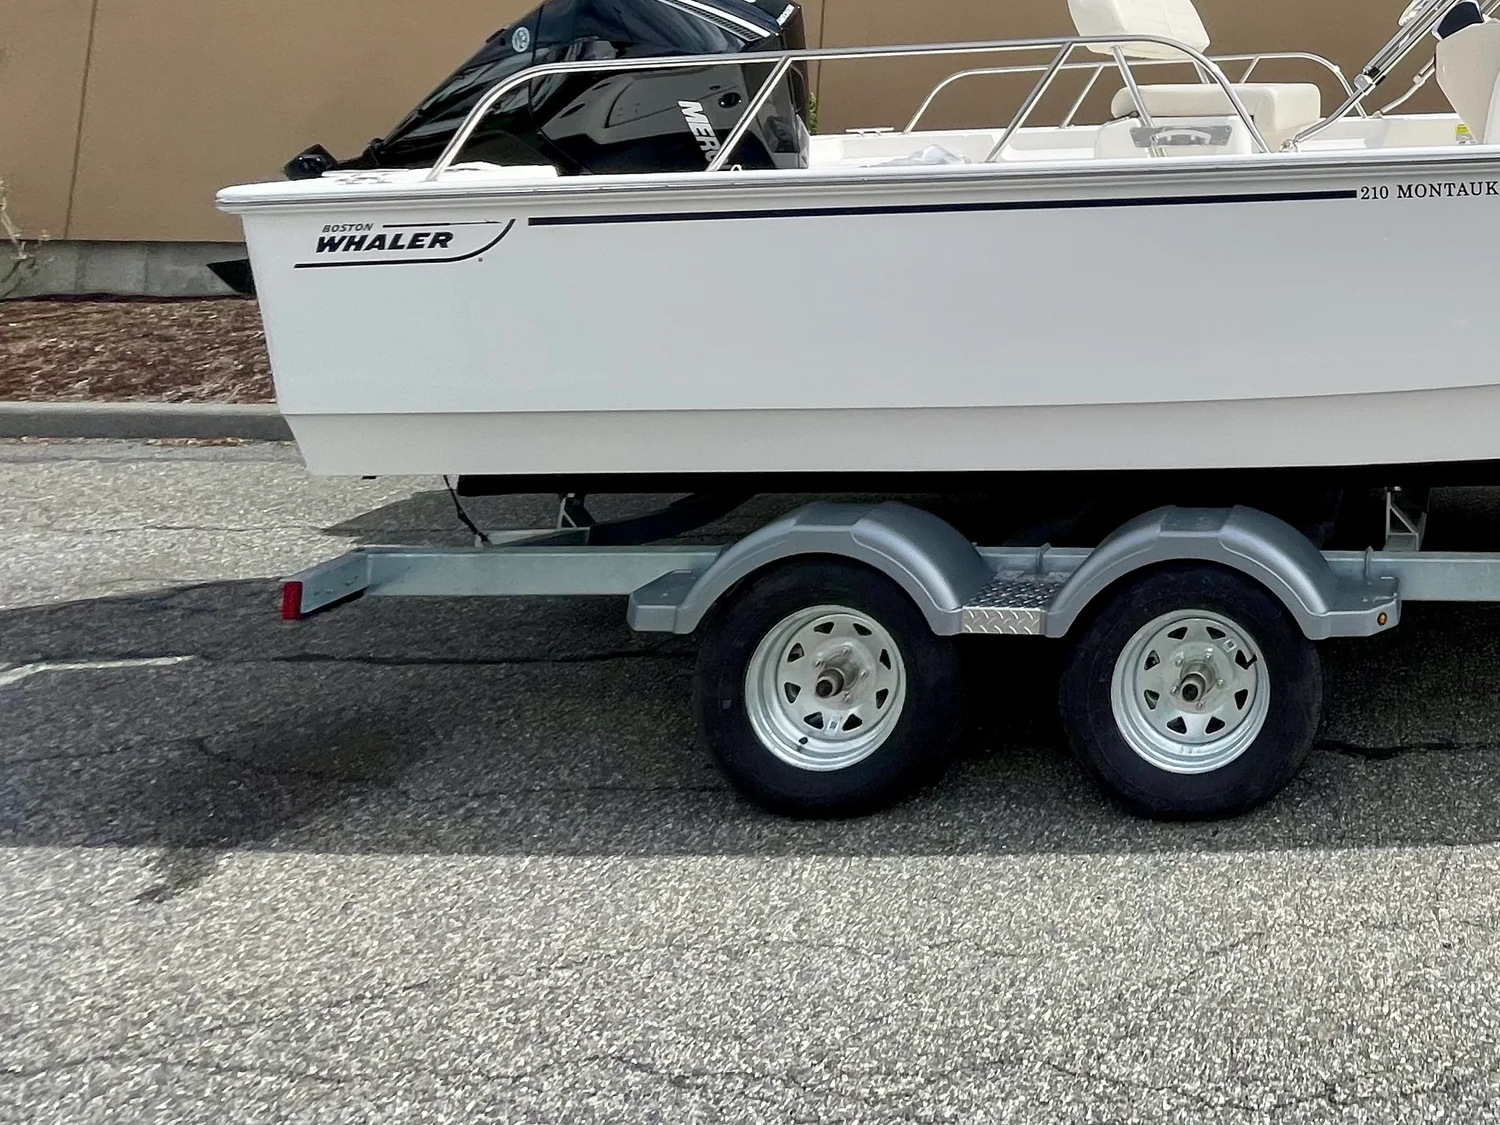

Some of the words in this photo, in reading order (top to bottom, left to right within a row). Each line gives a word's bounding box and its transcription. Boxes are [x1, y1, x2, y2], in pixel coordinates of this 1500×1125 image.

[677, 100, 732, 172] MERC
[1360, 185, 1389, 200] 210
[1396, 181, 1500, 199] MONTAUK
[322, 223, 374, 234] BOSTON
[315, 231, 455, 254] WHALER
